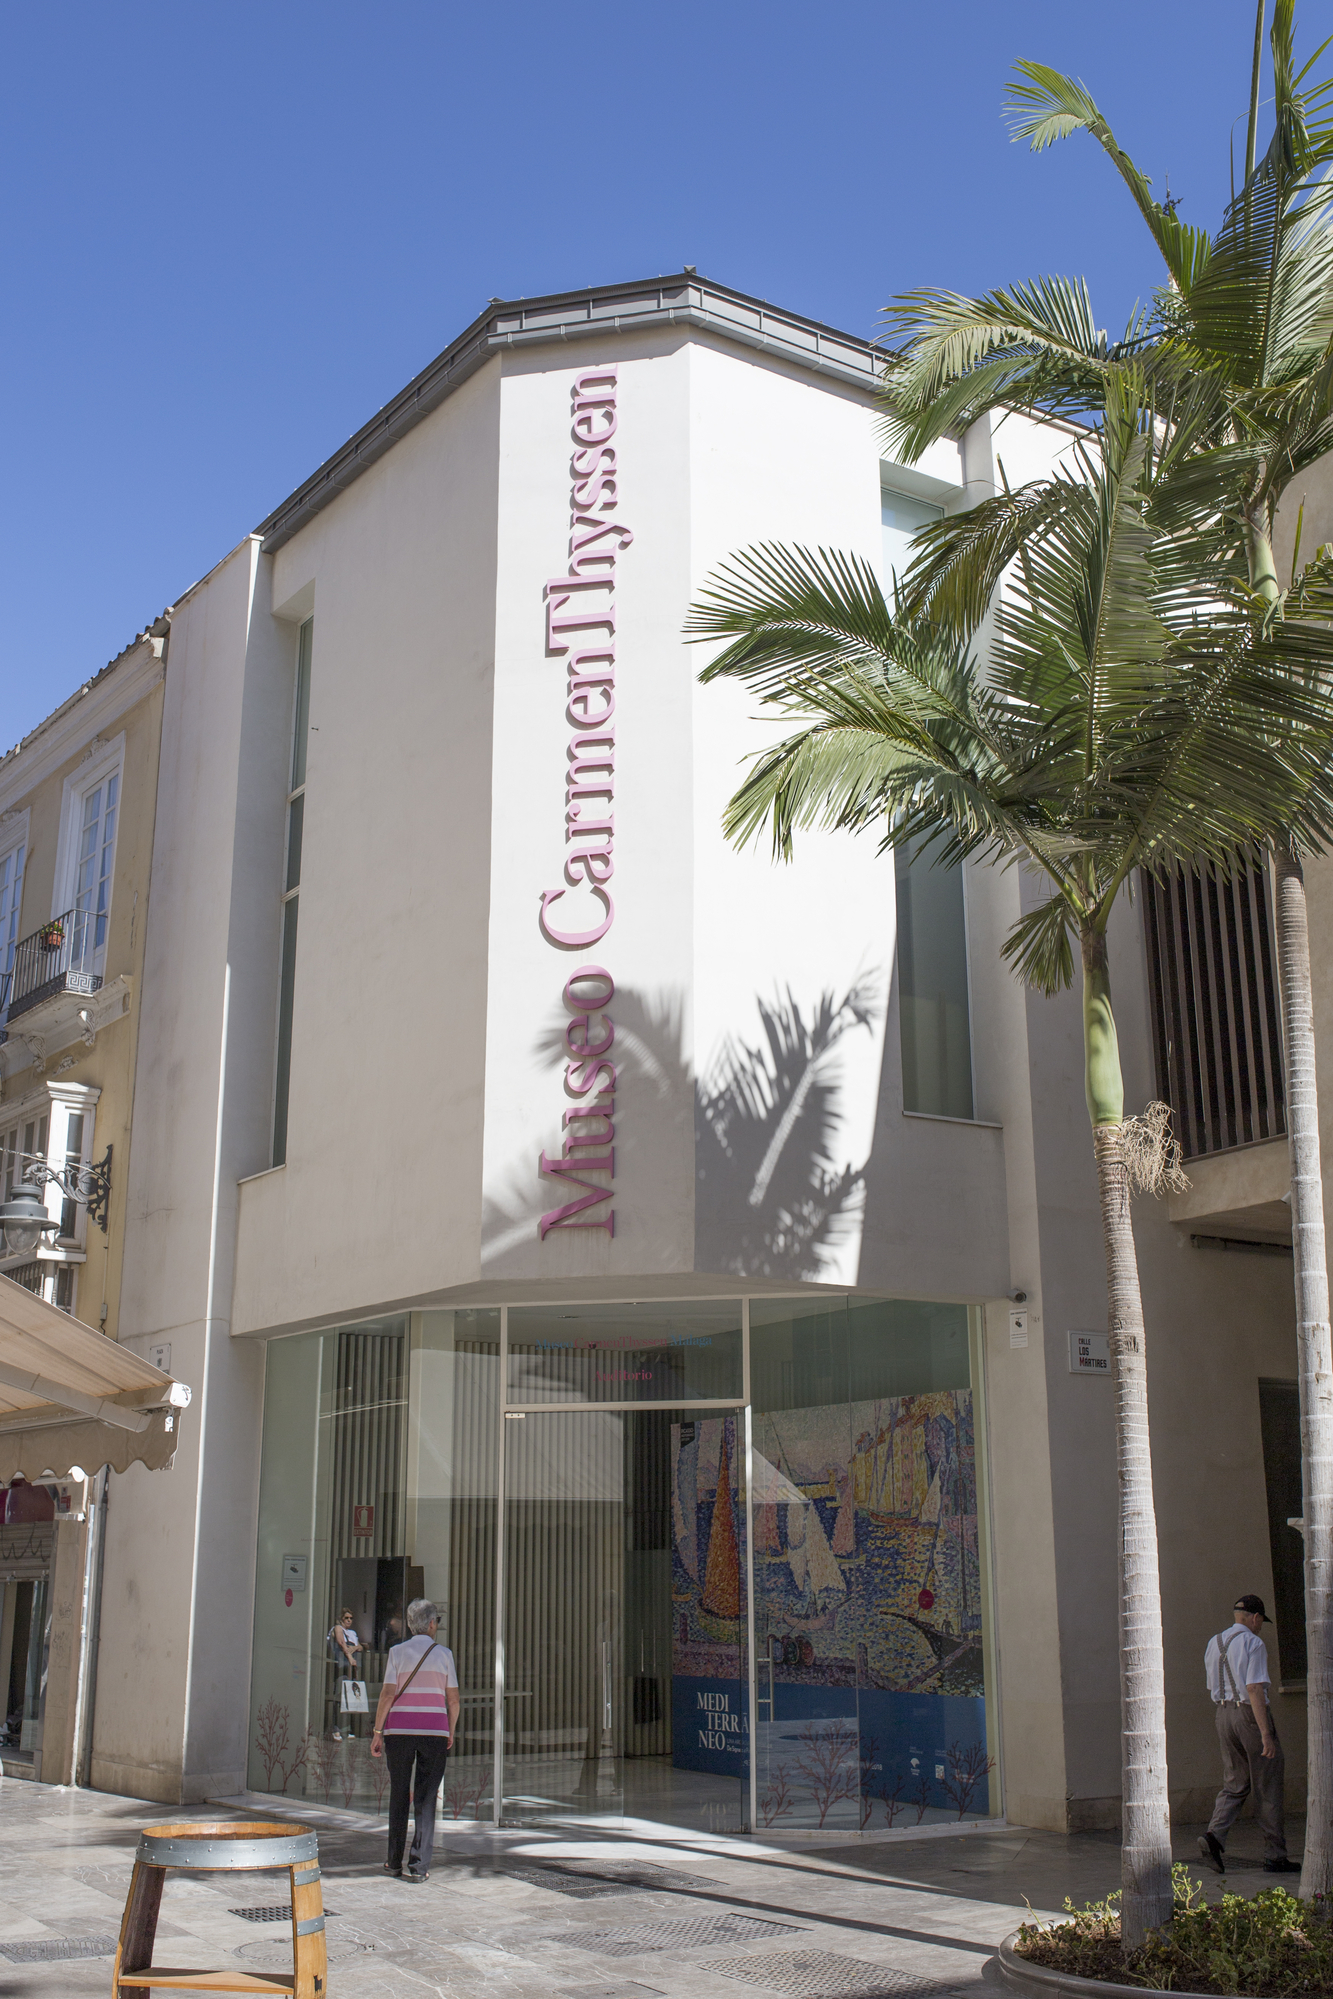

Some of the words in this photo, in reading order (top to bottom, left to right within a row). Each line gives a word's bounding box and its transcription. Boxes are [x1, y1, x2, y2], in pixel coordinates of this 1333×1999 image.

[670, 1334, 712, 1348] Málaga
[1078, 1337, 1091, 1345] CALLE
[1078, 1346, 1090, 1356] LOS
[593, 1369, 653, 1382] Auditorio
[697, 1691, 729, 1712] MEDI
[698, 1729, 726, 1750] NEO
